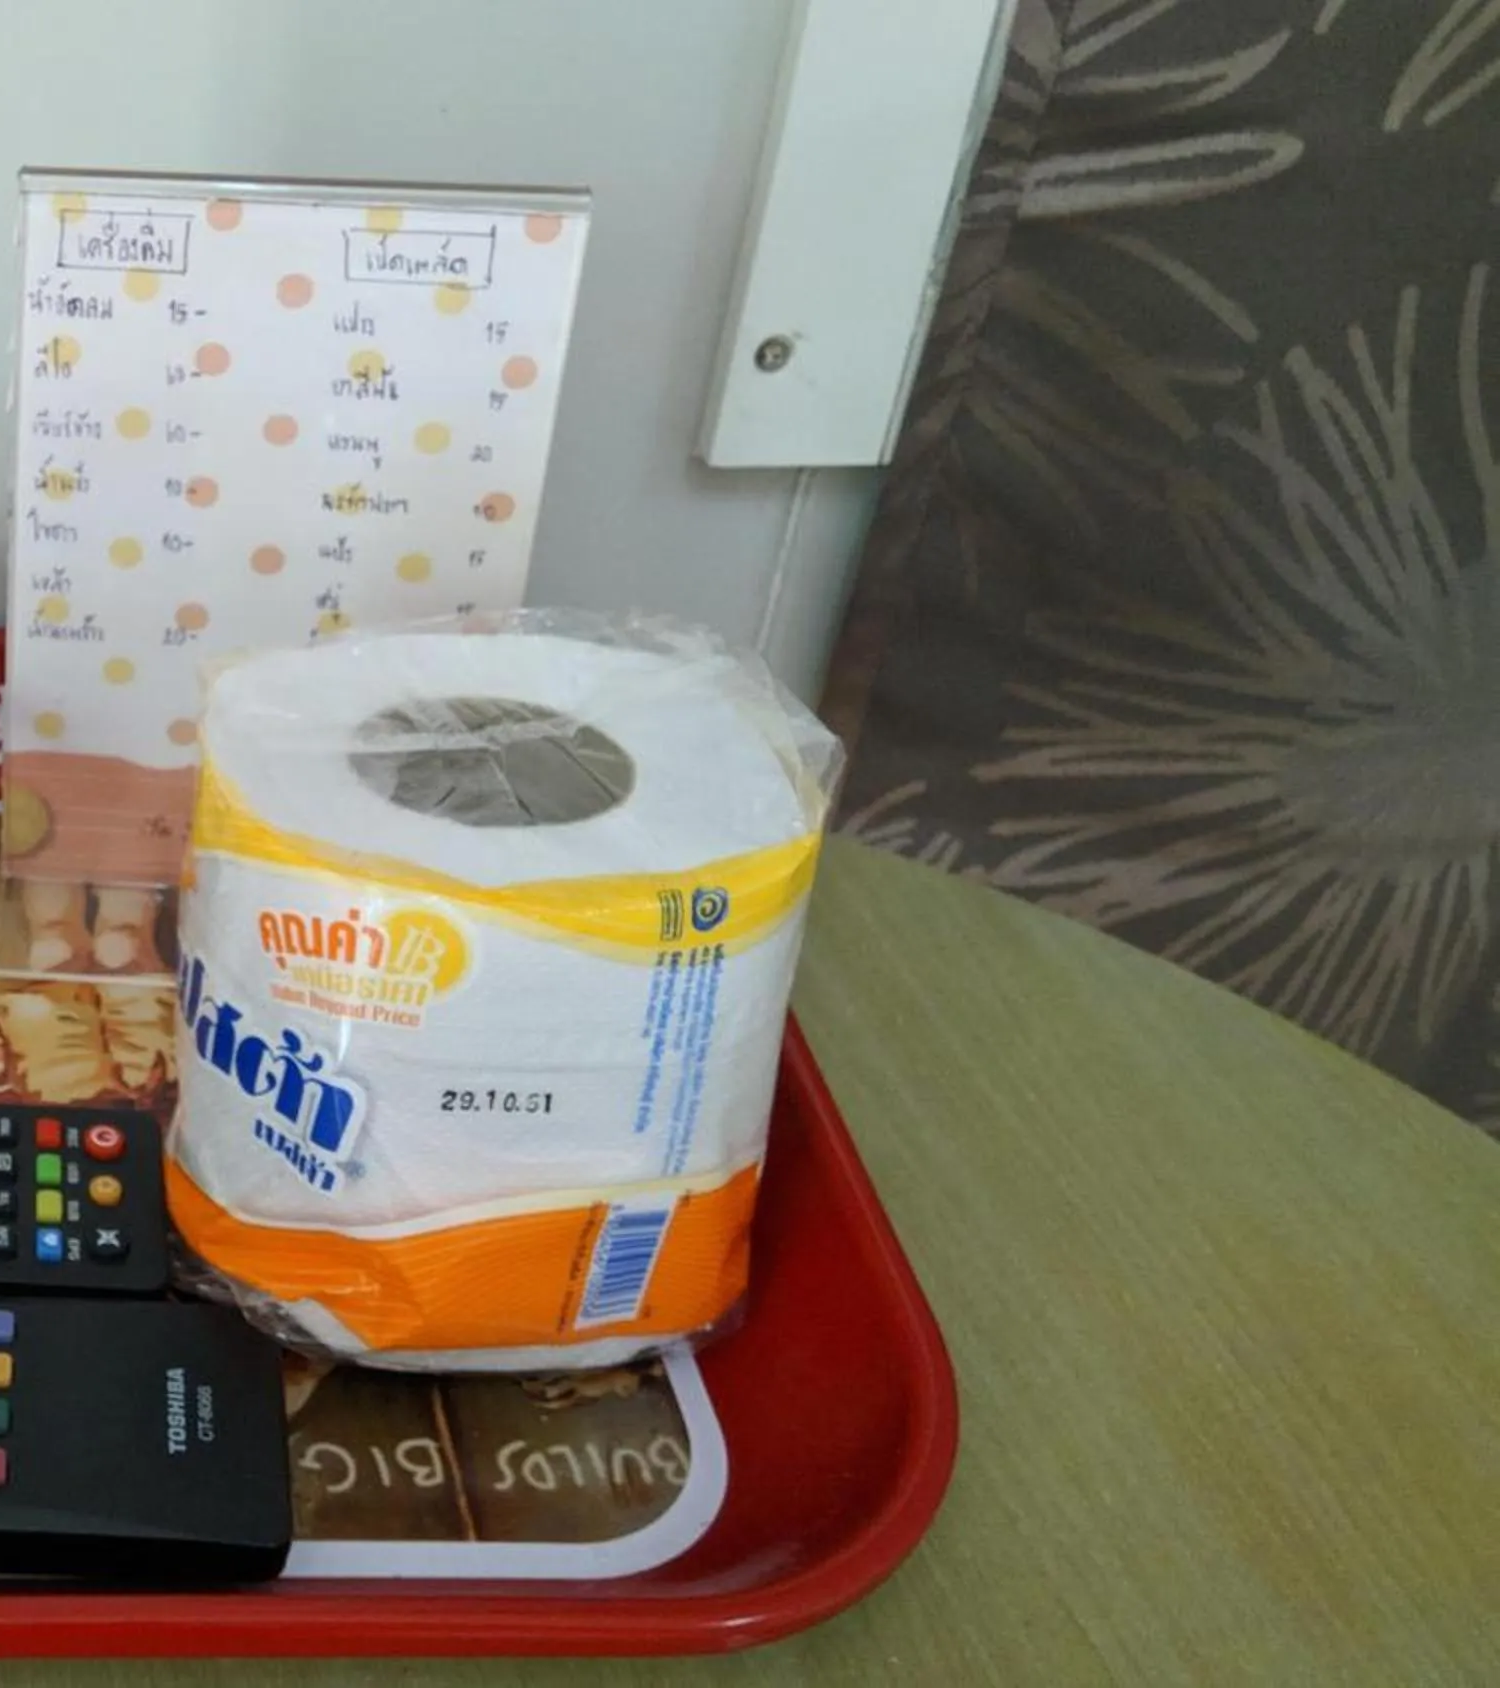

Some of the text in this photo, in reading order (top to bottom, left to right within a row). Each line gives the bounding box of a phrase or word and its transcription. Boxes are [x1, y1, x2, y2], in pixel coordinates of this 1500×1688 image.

[258, 908, 386, 971] คุณค่า
[165, 1367, 187, 1455] TOSHIBA
[300, 1437, 447, 1493] BIG
